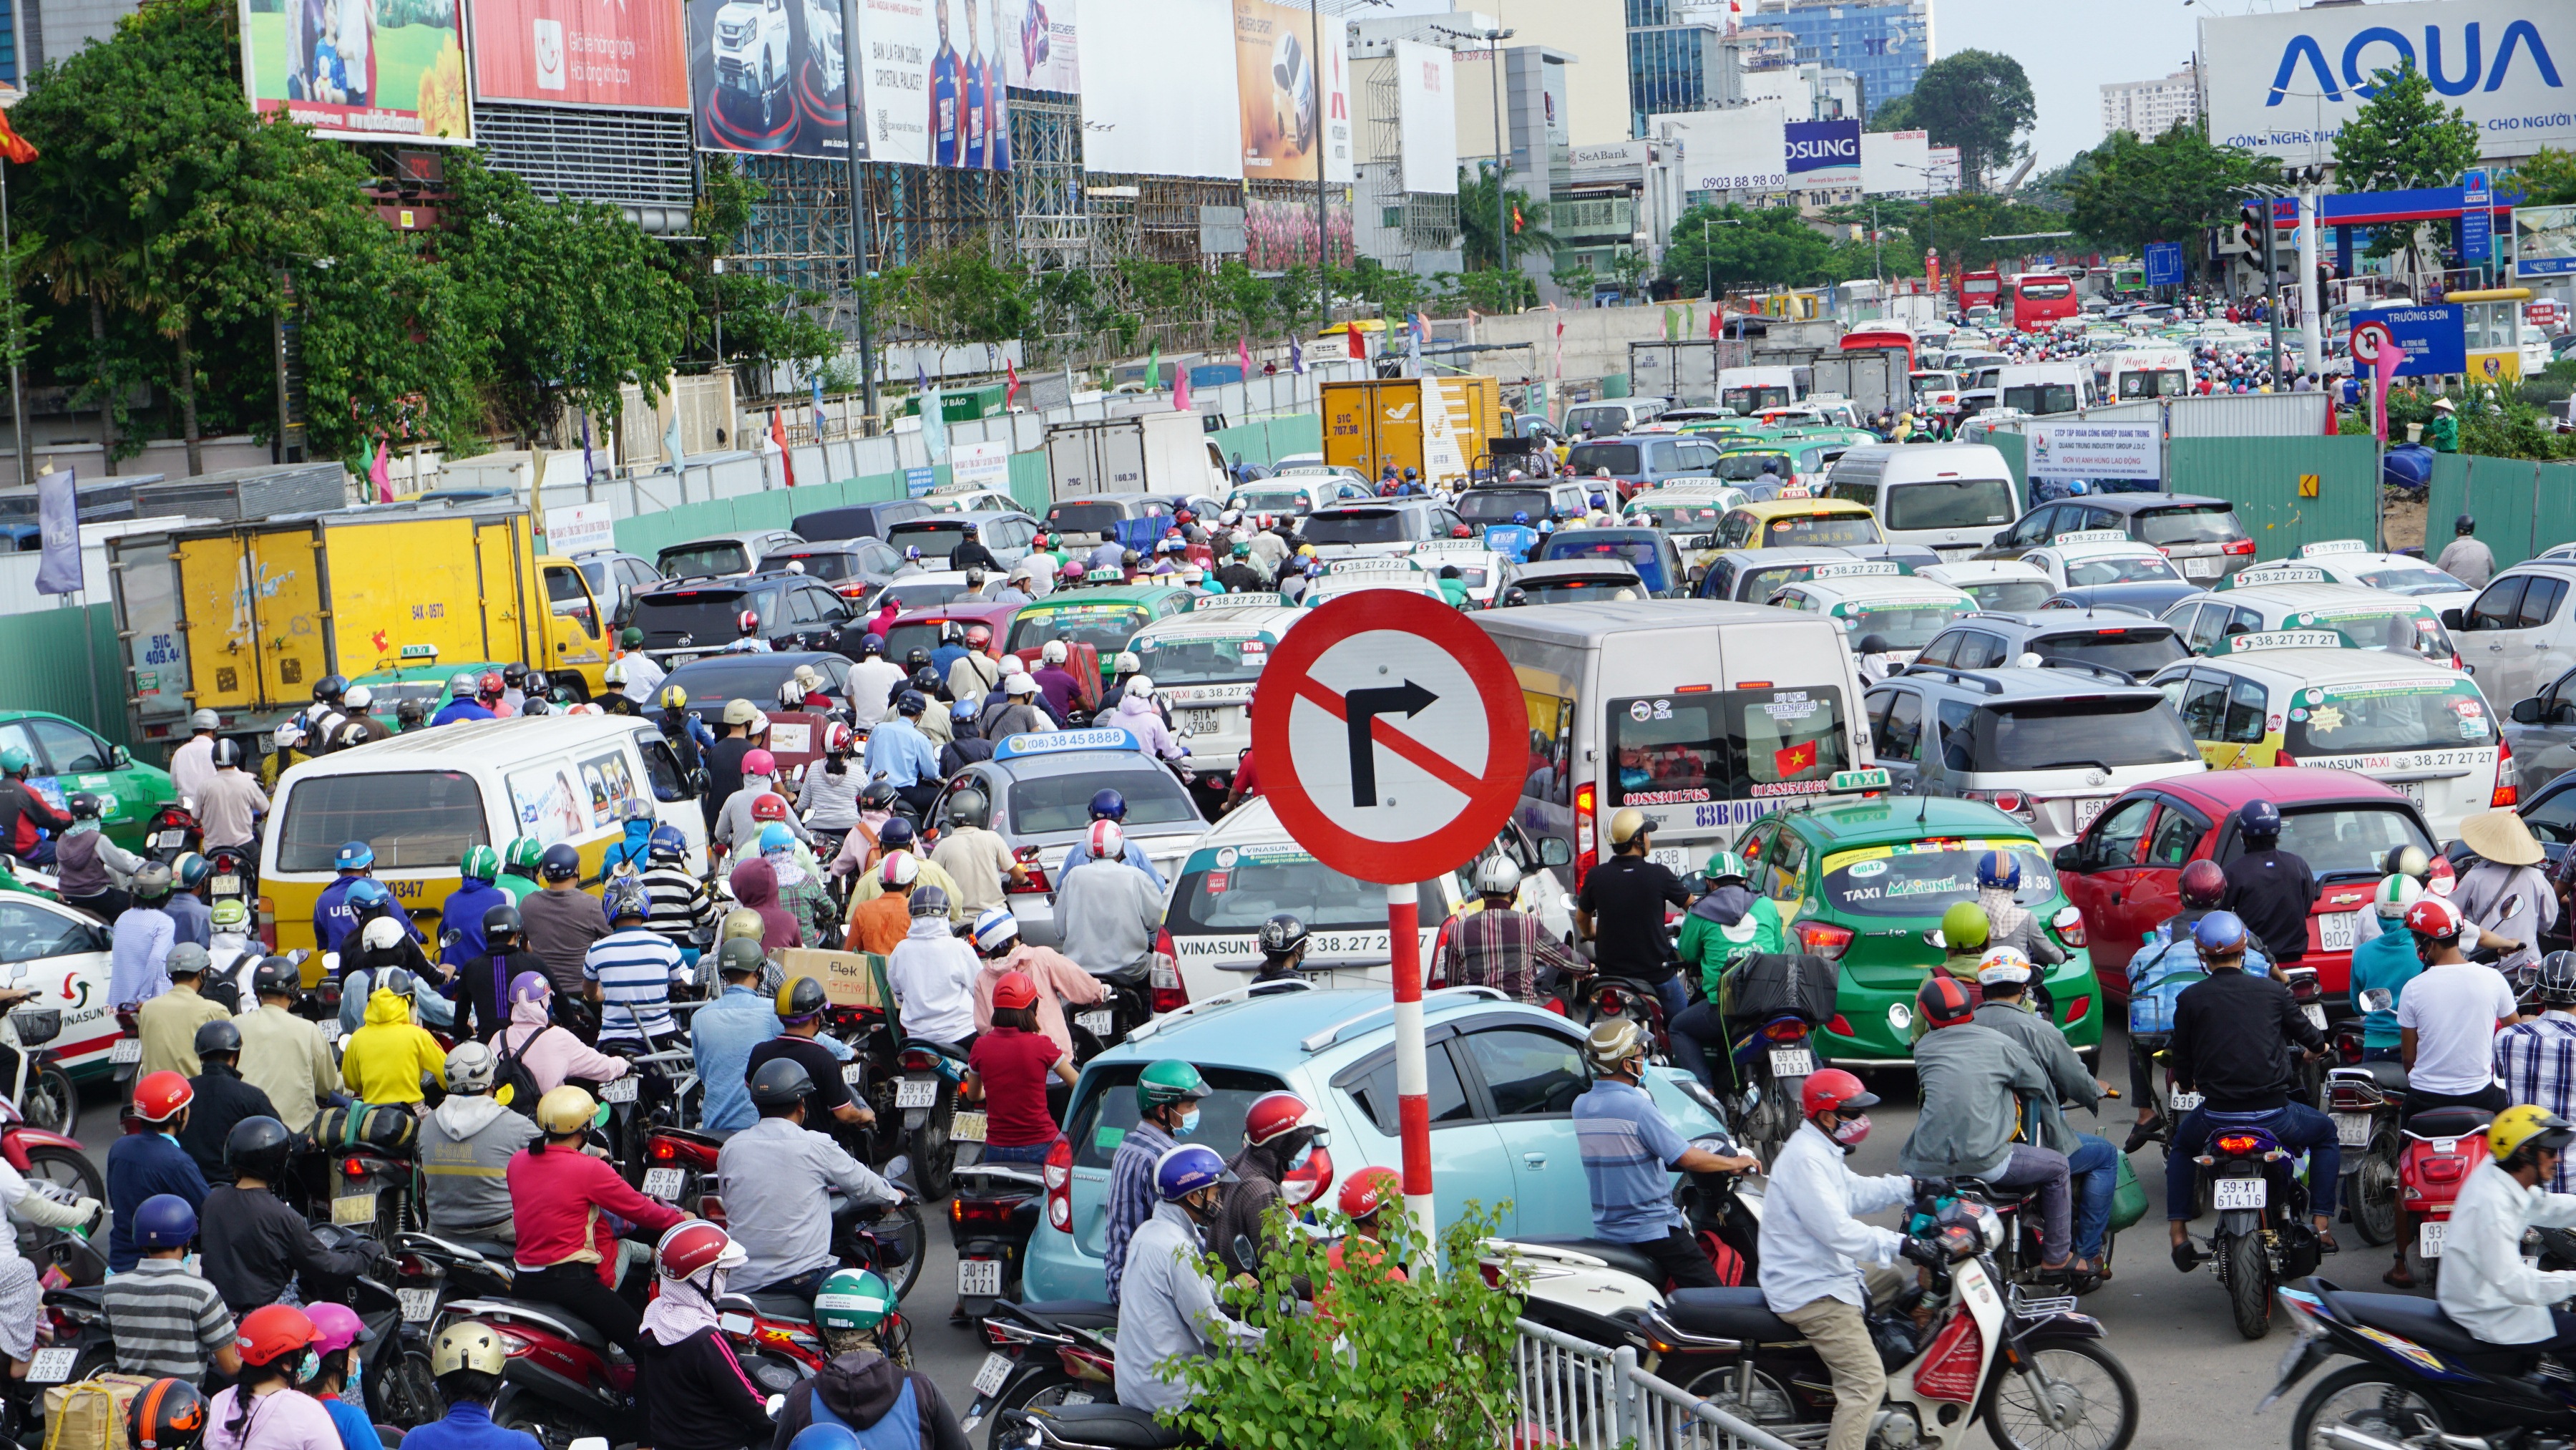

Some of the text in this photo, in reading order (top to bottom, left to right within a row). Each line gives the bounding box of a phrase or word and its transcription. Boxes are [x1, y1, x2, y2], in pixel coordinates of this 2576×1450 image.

[1050, 23, 1075, 35] SKECHERS
[1237, 15, 1272, 34] PAJERO SPORT
[894, 44, 904, 63] FAN
[1468, 51, 1478, 61] 39
[2265, 19, 2563, 107] AQUA
[876, 69, 922, 91] CRYSTAL PALACE?
[2488, 112, 2571, 130] CHO NGƯỜI
[1579, 149, 1629, 162] SeABank
[1702, 174, 1785, 189] 0903 88 98 00
[2273, 203, 2295, 215] OIL
[2387, 309, 2449, 322] TRƯỜNG SƠN
[950, 396, 966, 407] BÁO
[1337, 414, 1351, 423] 51C
[1333, 424, 1358, 435] 707.98
[2088, 427, 2099, 437] CÔNG
[2076, 457, 2081, 465] VỊ
[2094, 455, 2109, 464] HÙNG
[2124, 456, 2141, 466] ĐỘNG
[1068, 473, 1137, 487] 29C 160.39
[1808, 532, 1853, 543] 38 38 38 38
[1349, 560, 1390, 571] 38.27 27
[1834, 565, 1864, 575] 38.27
[1868, 565, 1880, 573] 27
[2254, 570, 2320, 582] 38.27 27 27
[1216, 596, 1246, 605] 38.27
[412, 603, 444, 621] 54X 0573
[1243, 642, 1264, 651] 6765
[2255, 635, 2335, 646] 38.27 27 27
[1101, 653, 1112, 664] 38
[1209, 688, 1241, 698] 38.27
[1787, 692, 1806, 703] LỊCH
[1765, 699, 1816, 713] THIÊN PHÚ
[2458, 701, 2481, 714] 8243
[1194, 711, 1211, 721] 51A
[1028, 731, 1121, 749] (08) 38 45 8888
[2414, 751, 2492, 767] 38.27 27 27
[1750, 781, 1828, 798] 0128954363
[1624, 789, 1709, 807] 0988301768
[1696, 804, 1729, 827] 83B
[1655, 850, 1679, 864] 83B
[1854, 862, 1880, 875] 9042
[2036, 875, 2051, 890] 38
[1843, 882, 1971, 901] TAXI (08)
[1317, 936, 1370, 951] 38.27
[1728, 942, 1764, 958] Grab
[831, 961, 857, 976] Elek
[2550, 974, 2566, 983] Sport
[1080, 1013, 1106, 1023] 59-V1
[115, 1050, 136, 1061] 9558
[1776, 1051, 1804, 1062] 69-C1
[1775, 1063, 1811, 1074] 078.31
[904, 1083, 930, 1094] 59-V2
[899, 1094, 932, 1105] 212.67
[957, 1127, 983, 1138] 4598
[650, 1172, 676, 1184] 59-X2
[1072, 1172, 1106, 1182] CHEVROLET
[645, 1185, 677, 1197] 182.80
[2223, 1182, 2256, 1193] 59-X1
[2218, 1194, 2262, 1207] 614.16
[964, 1263, 994, 1277] 30-F1
[963, 1280, 994, 1293] 4121
[39, 1352, 67, 1364] 59-G2
[33, 1366, 68, 1379] 236.93
[985, 1357, 1009, 1377] 79-H5
[975, 1376, 999, 1393] 8046
